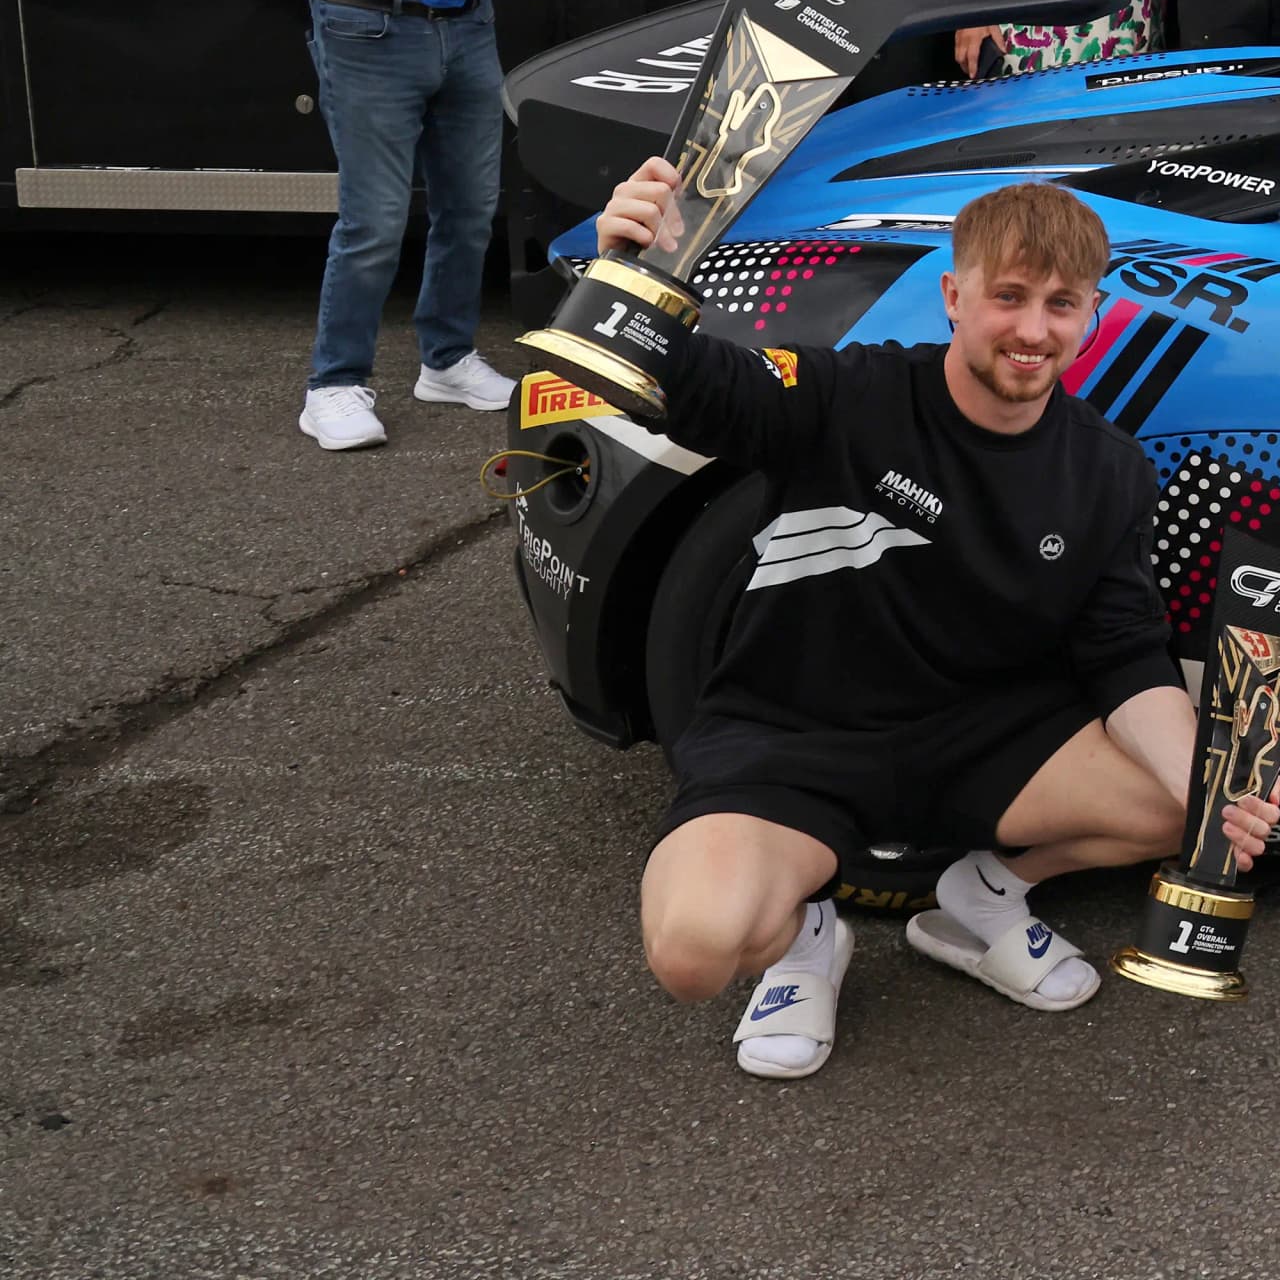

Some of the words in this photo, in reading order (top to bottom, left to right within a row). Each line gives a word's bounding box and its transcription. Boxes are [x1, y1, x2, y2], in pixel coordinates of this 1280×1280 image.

[797, 13, 861, 56] CHAMPIONSHIP
[803, 6, 841, 32] BRITISH
[834, 23, 850, 38] GT
[593, 301, 628, 338] 1
[634, 312, 652, 325] GT4
[628, 319, 656, 339] SILVER
[654, 334, 669, 346] CUP
[1169, 920, 1194, 954] 1
[1196, 933, 1228, 945] OVERALL
[1200, 925, 1215, 935] GT4
[759, 984, 801, 1007] NIKE
